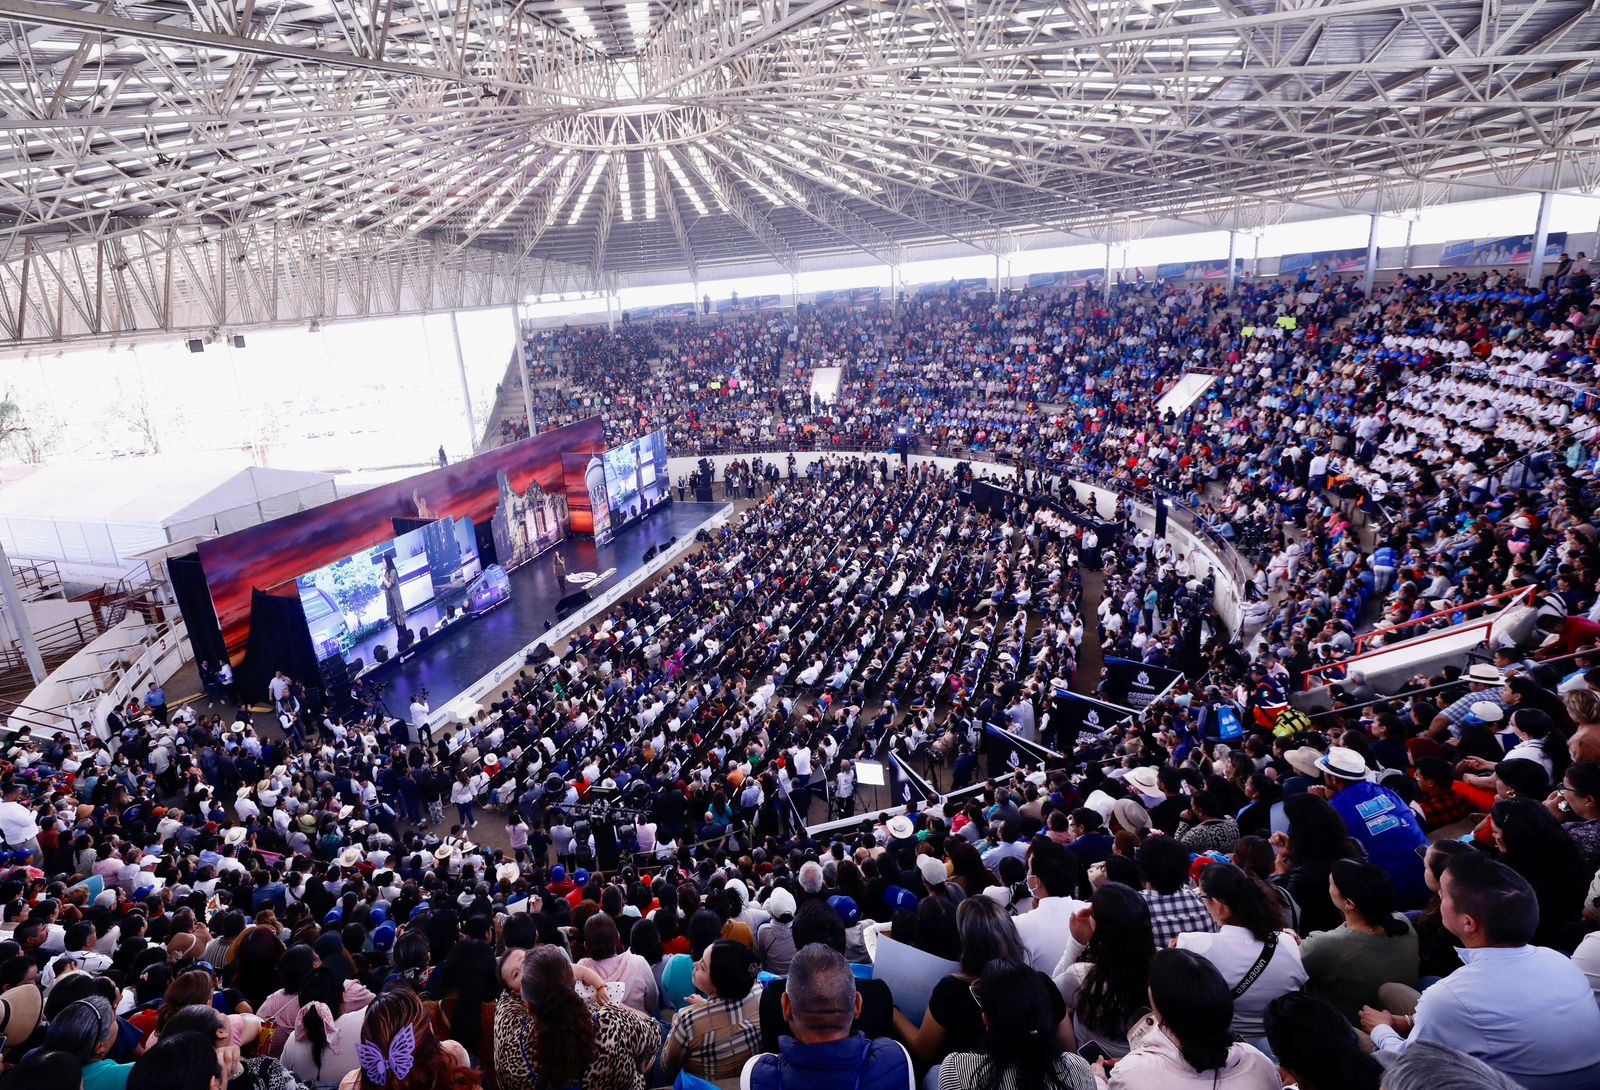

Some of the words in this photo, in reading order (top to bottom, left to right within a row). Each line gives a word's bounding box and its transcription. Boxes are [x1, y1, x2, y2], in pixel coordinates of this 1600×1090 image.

[160, 639, 166, 650] 3
[136, 663, 142, 675] 2
[1236, 959, 1266, 993] UNDEFINED
